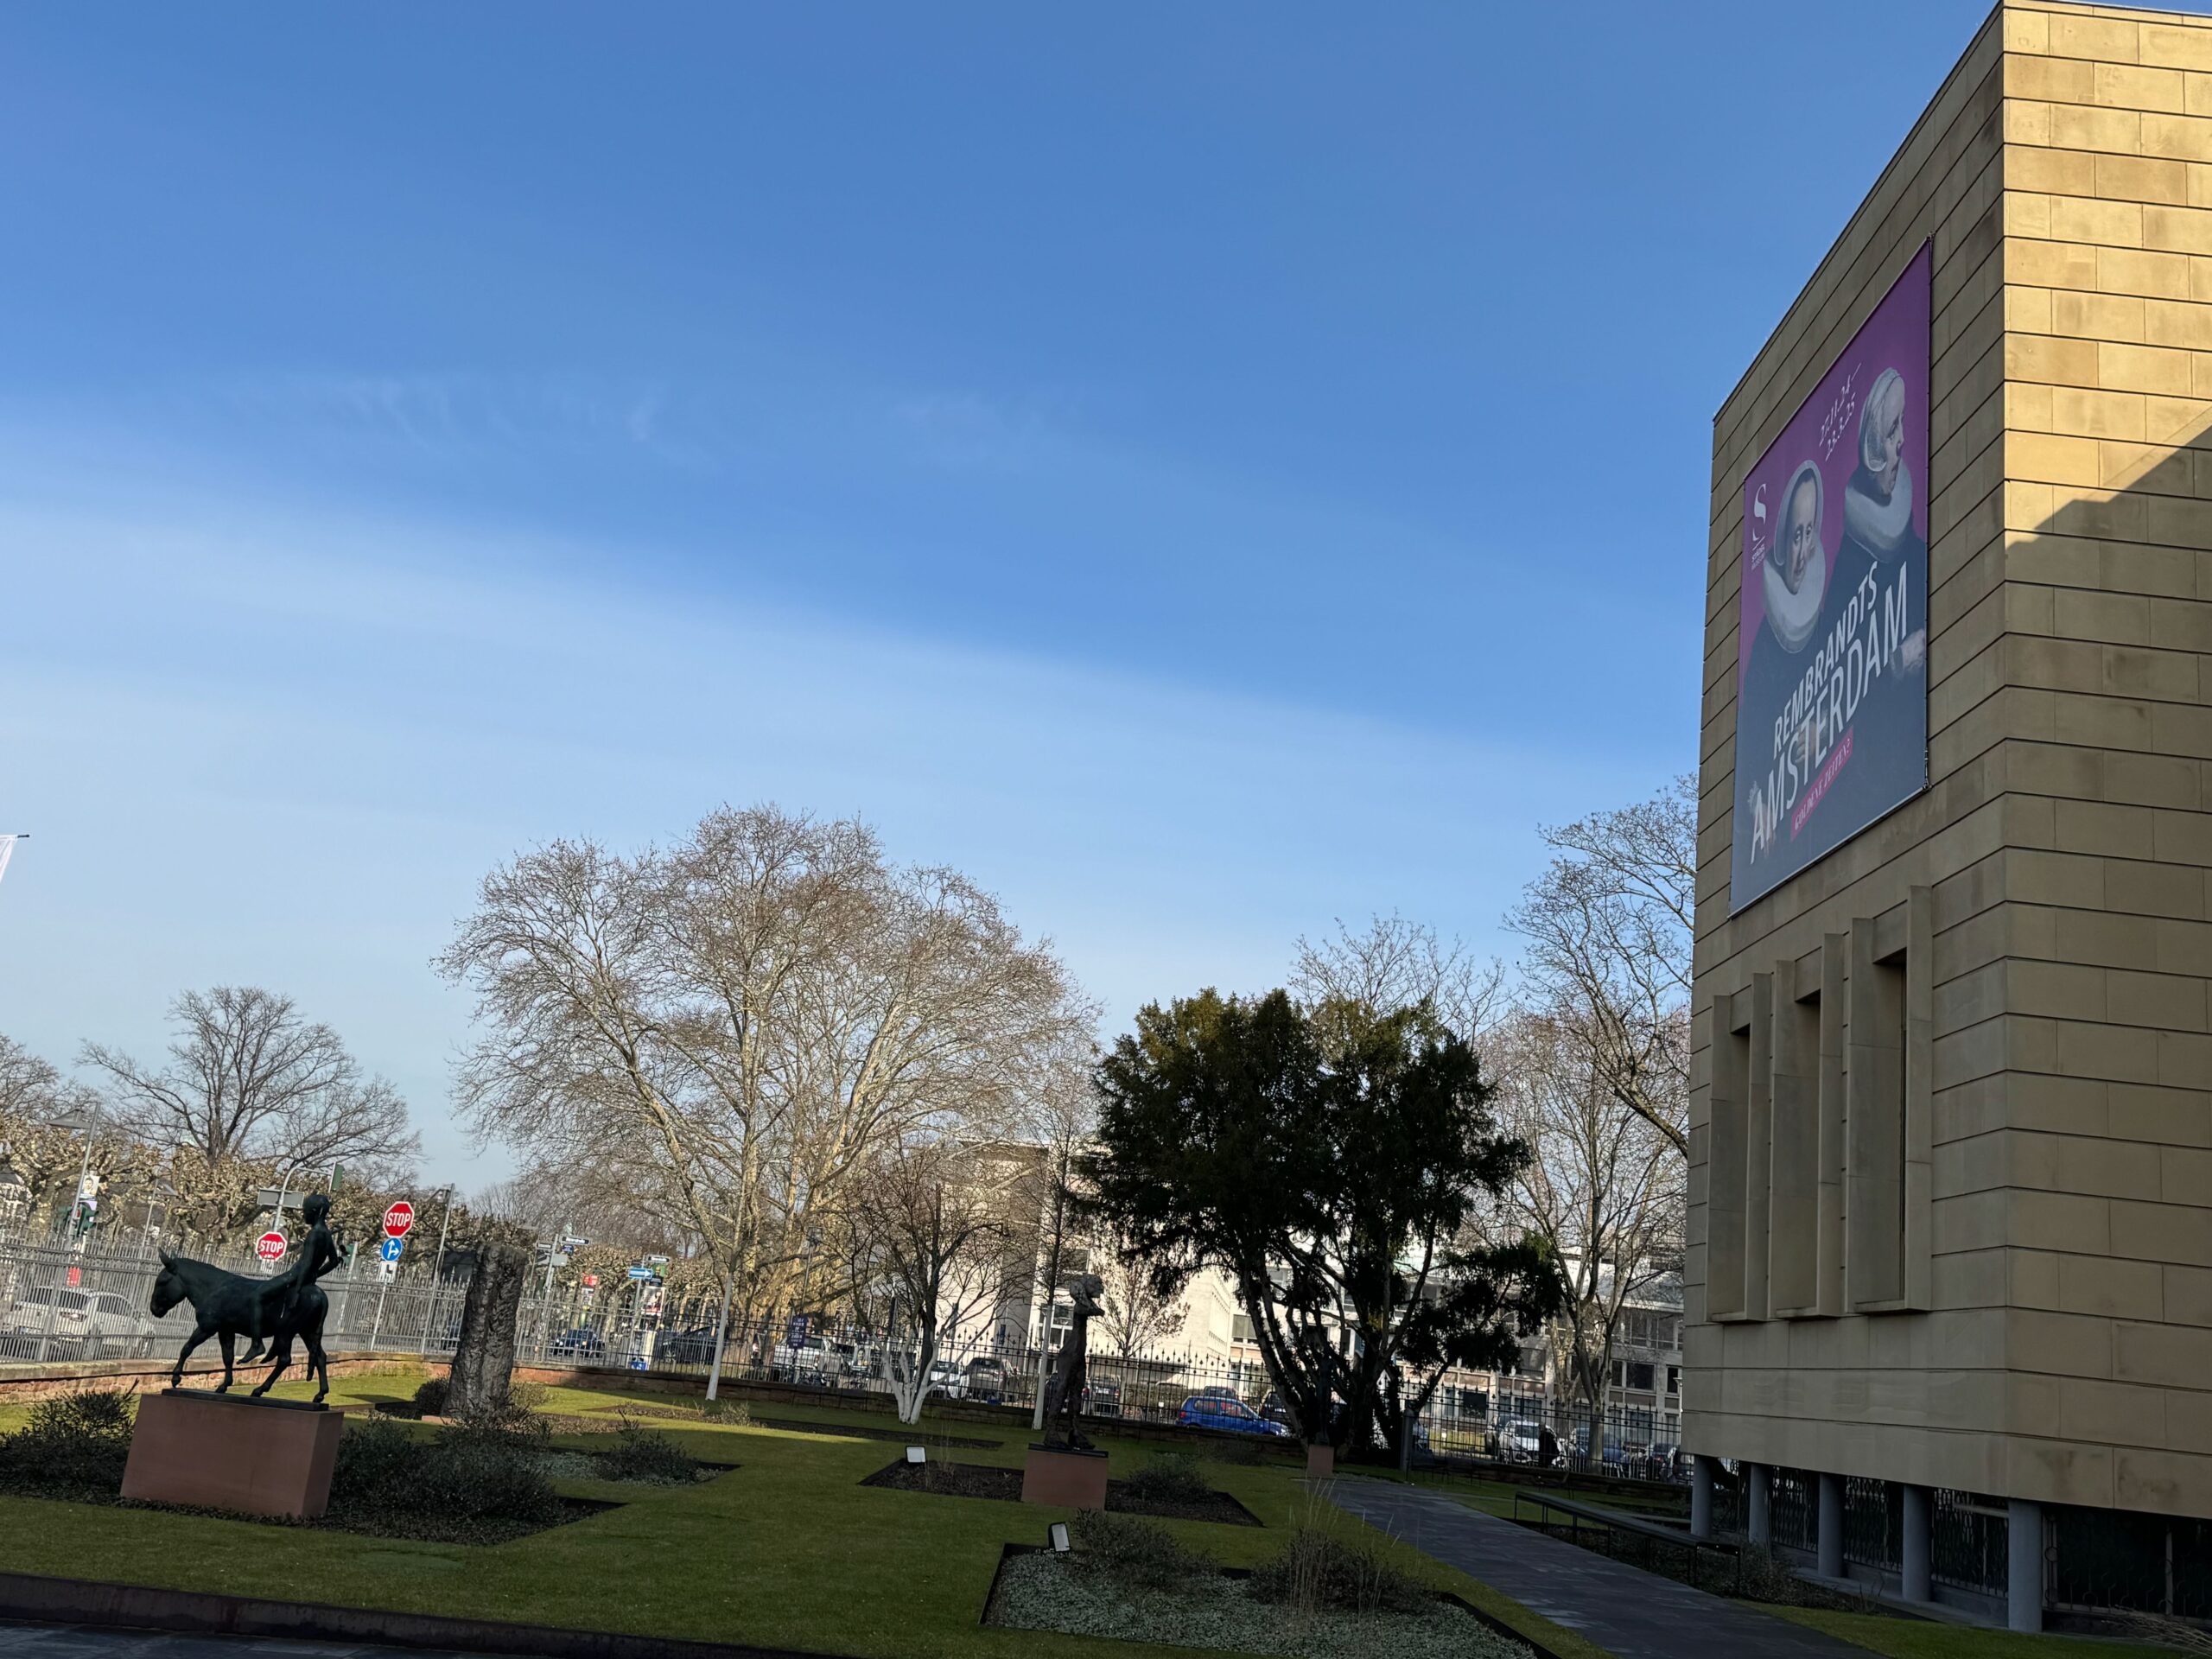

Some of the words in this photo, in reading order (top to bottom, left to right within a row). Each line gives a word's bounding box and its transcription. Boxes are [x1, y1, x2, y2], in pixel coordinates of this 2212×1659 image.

[1751, 560, 1907, 865] AMSTERDAM
[1774, 560, 1878, 760] REMBRANDTS
[259, 1240, 284, 1254] STOP
[385, 1212, 411, 1227] STOP
